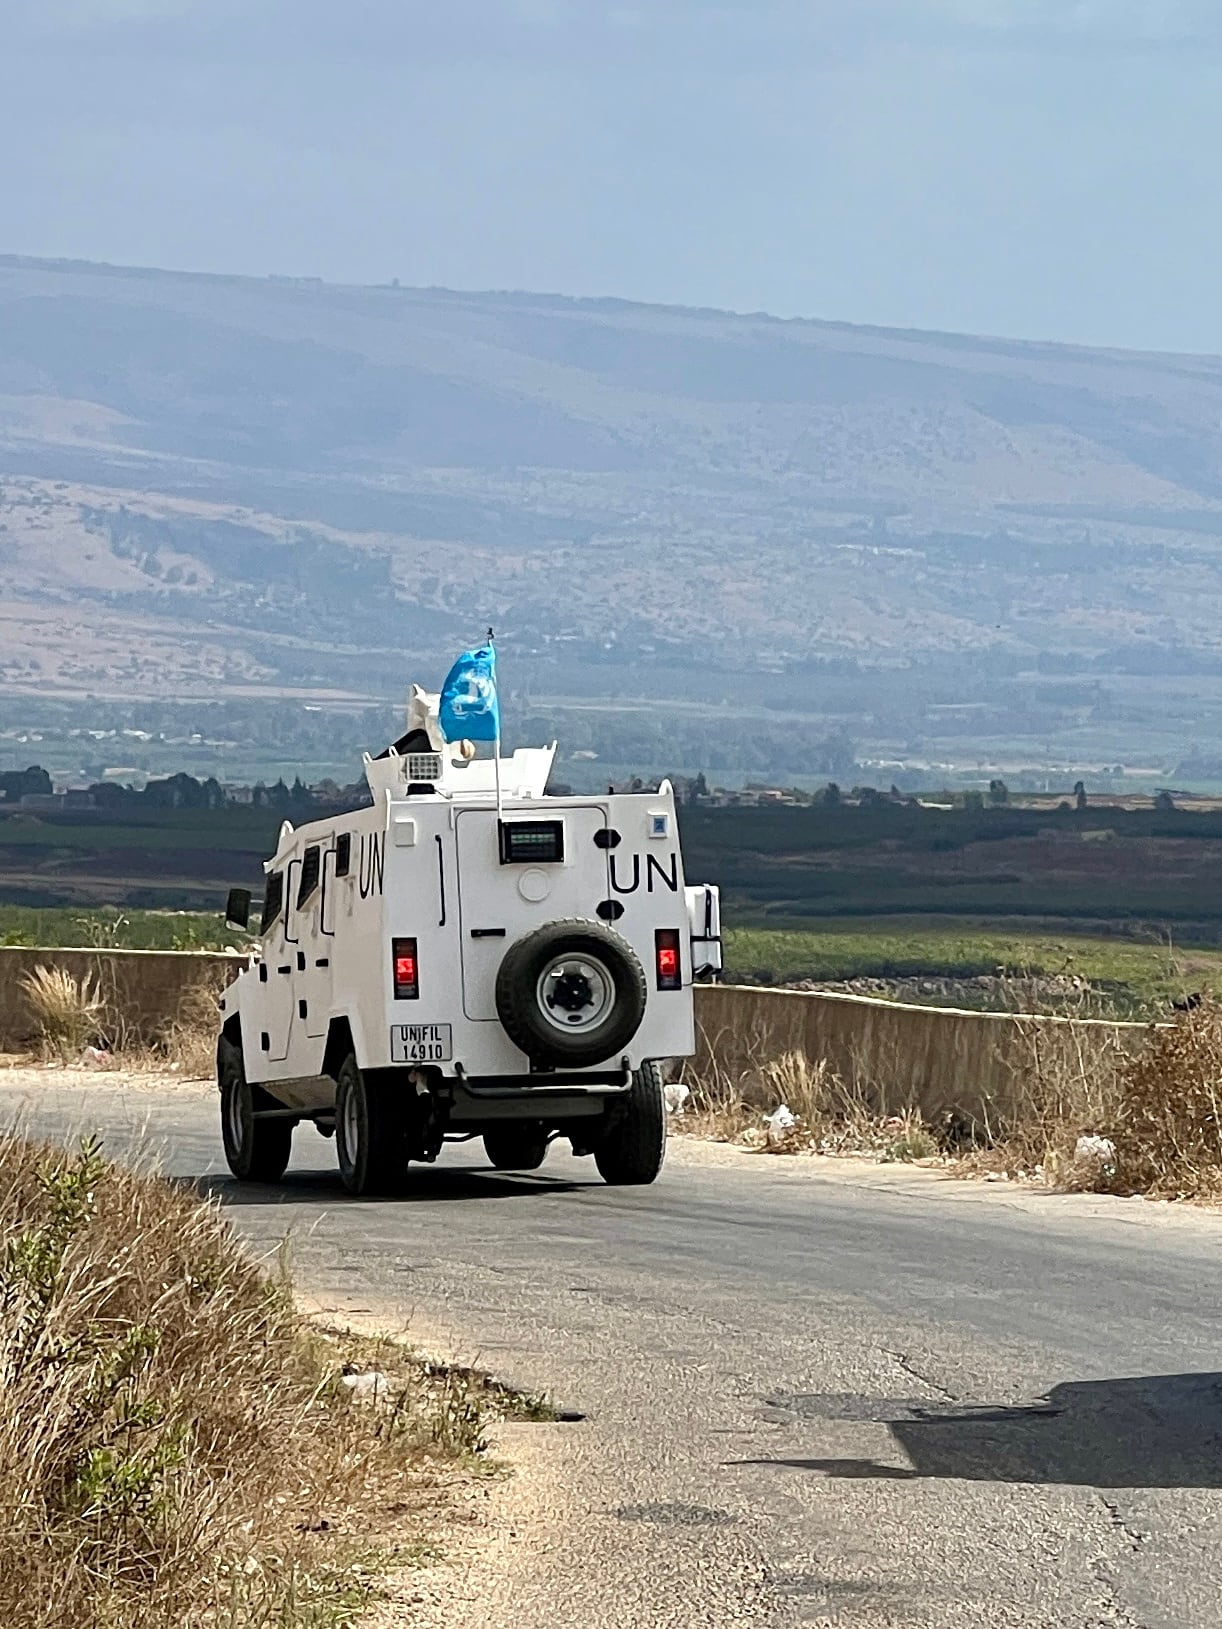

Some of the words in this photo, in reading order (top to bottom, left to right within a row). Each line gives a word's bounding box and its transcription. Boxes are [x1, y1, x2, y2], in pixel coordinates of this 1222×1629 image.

[360, 830, 385, 899] UN
[609, 853, 678, 894] UN
[401, 1026, 442, 1041] UNIFIL
[403, 1044, 442, 1060] 14910
